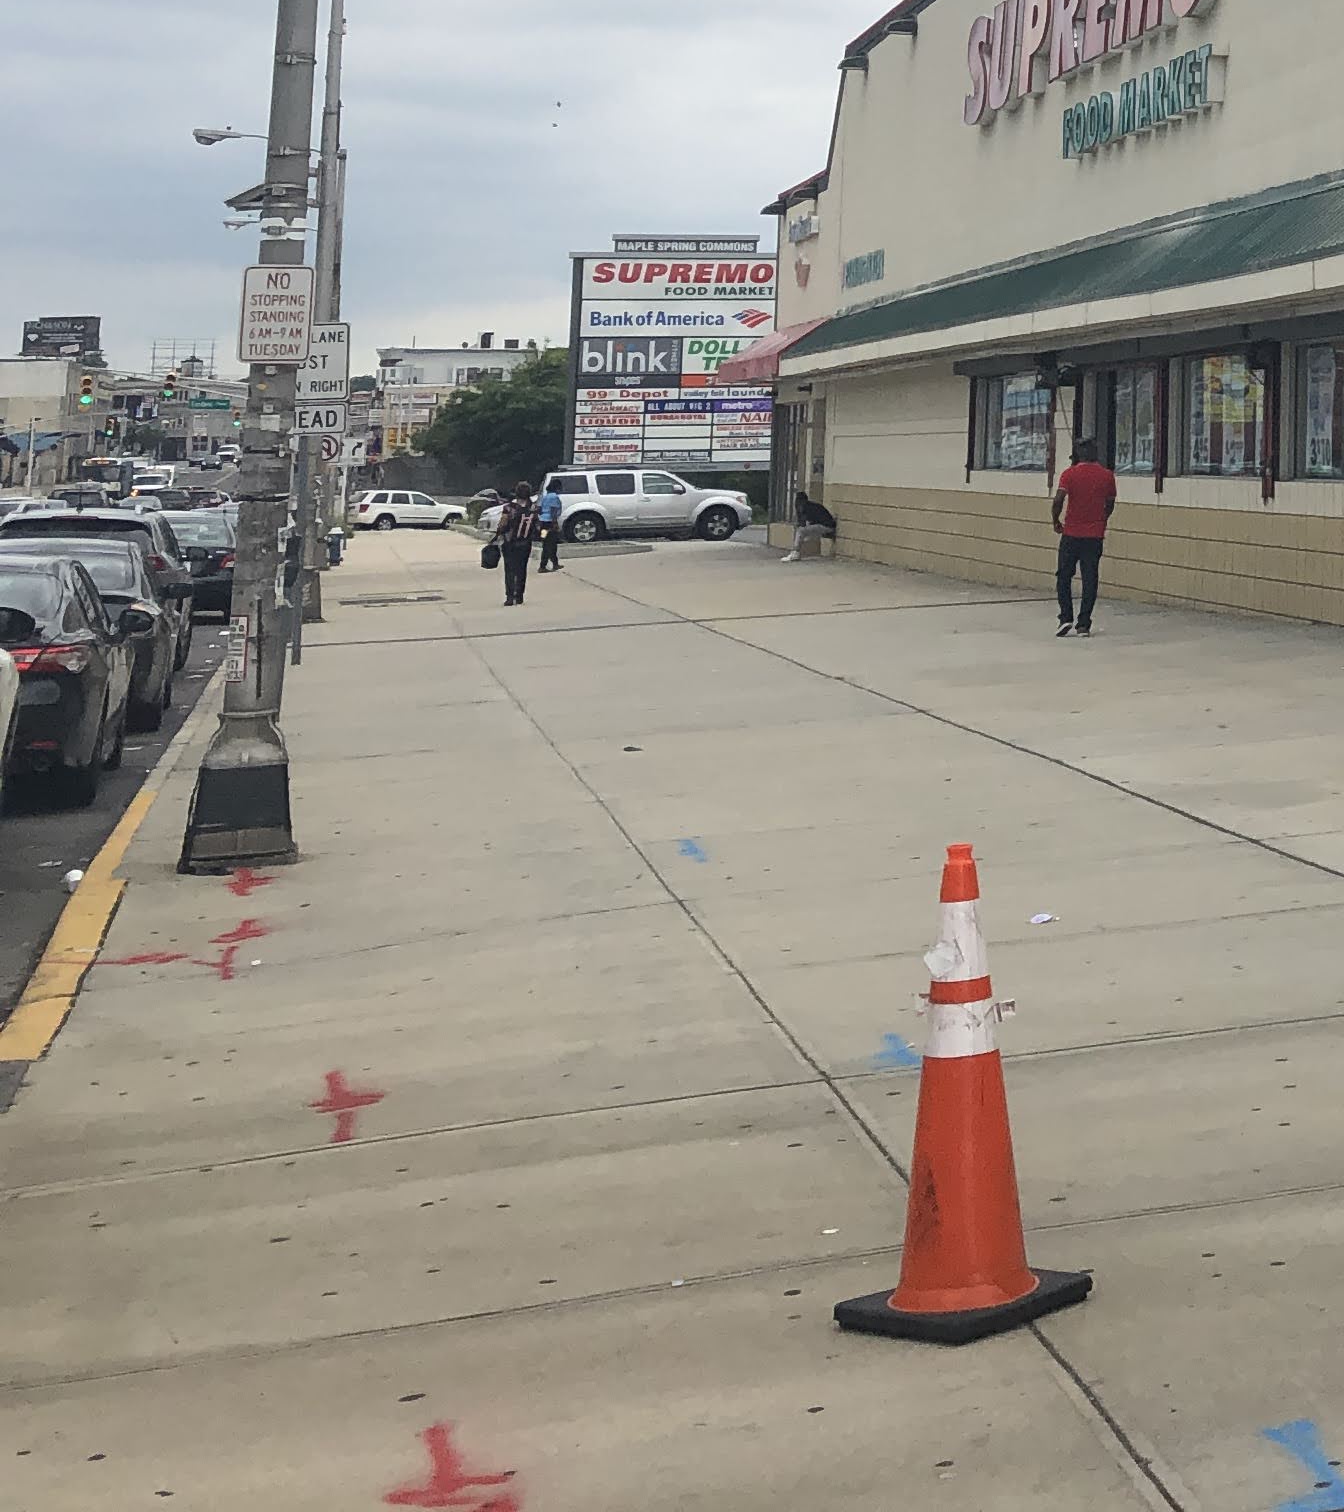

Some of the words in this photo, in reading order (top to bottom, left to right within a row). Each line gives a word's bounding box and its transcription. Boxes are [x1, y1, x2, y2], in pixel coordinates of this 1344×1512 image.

[1063, 90, 1114, 159] FOOD
[1119, 43, 1216, 135] MARKET
[617, 241, 655, 251] MAPLE
[657, 241, 697, 251] SPRING
[699, 241, 755, 252] COMMONS
[592, 262, 774, 284] SUPREMO
[267, 272, 291, 290] NO
[664, 286, 708, 296] FOOD
[713, 286, 774, 296] MARKET
[249, 294, 306, 307] STOPPING
[249, 310, 305, 323] STANDING
[590, 310, 634, 326] Bank
[635, 310, 654, 326] of
[655, 310, 725, 326] America
[288, 327, 303, 339] AM
[311, 331, 345, 343] LANE
[248, 343, 301, 357] TUESDAY
[688, 339, 741, 355] DOLL
[581, 340, 669, 373] blink
[310, 380, 344, 393] RIGHT
[619, 389, 669, 400] Depot
[295, 409, 338, 429] EAD
[739, 413, 772, 423] NAI
